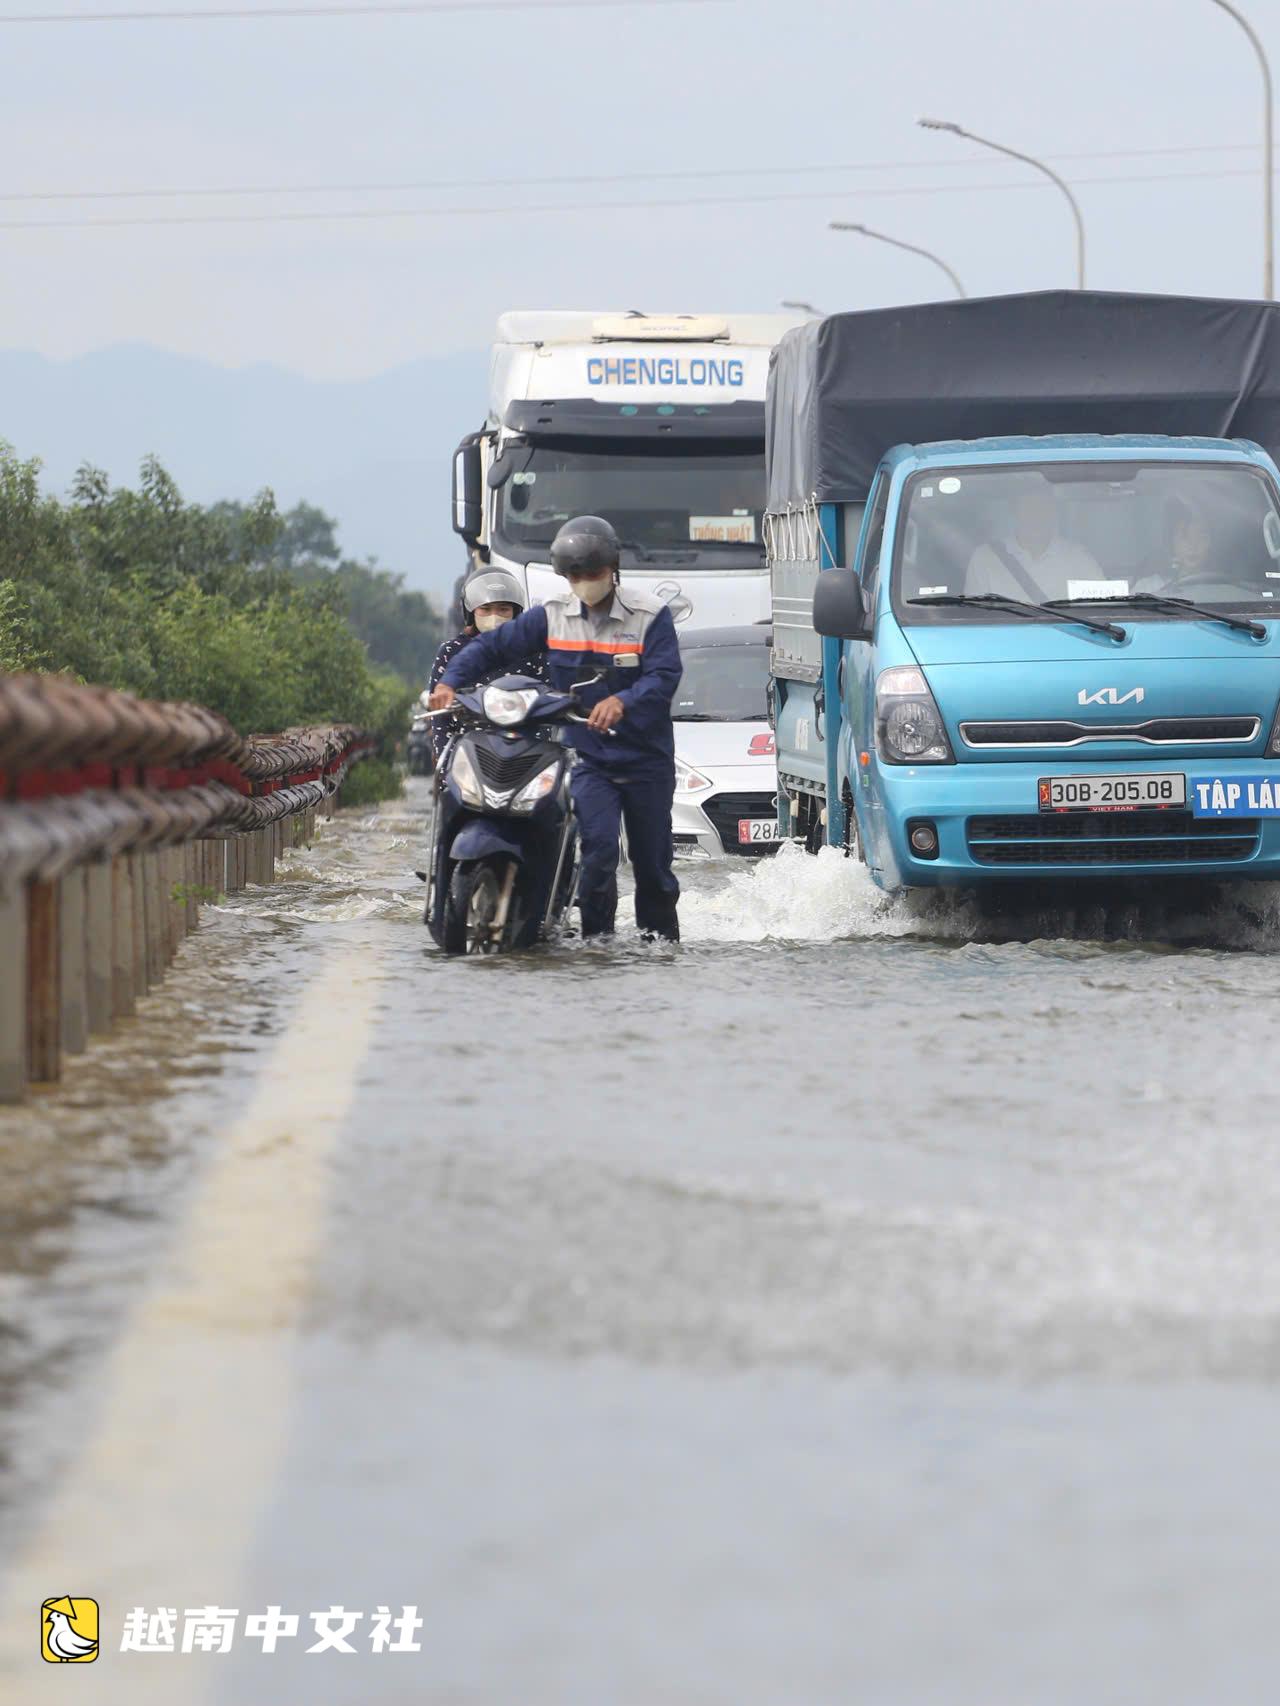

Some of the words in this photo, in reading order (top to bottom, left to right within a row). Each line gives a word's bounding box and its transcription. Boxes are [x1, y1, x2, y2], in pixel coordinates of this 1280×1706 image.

[587, 358, 743, 386] CHENGLONG
[1078, 687, 1145, 705] KIA
[1052, 780, 1173, 803] 30B-205.08
[1196, 779, 1241, 815] TẬP
